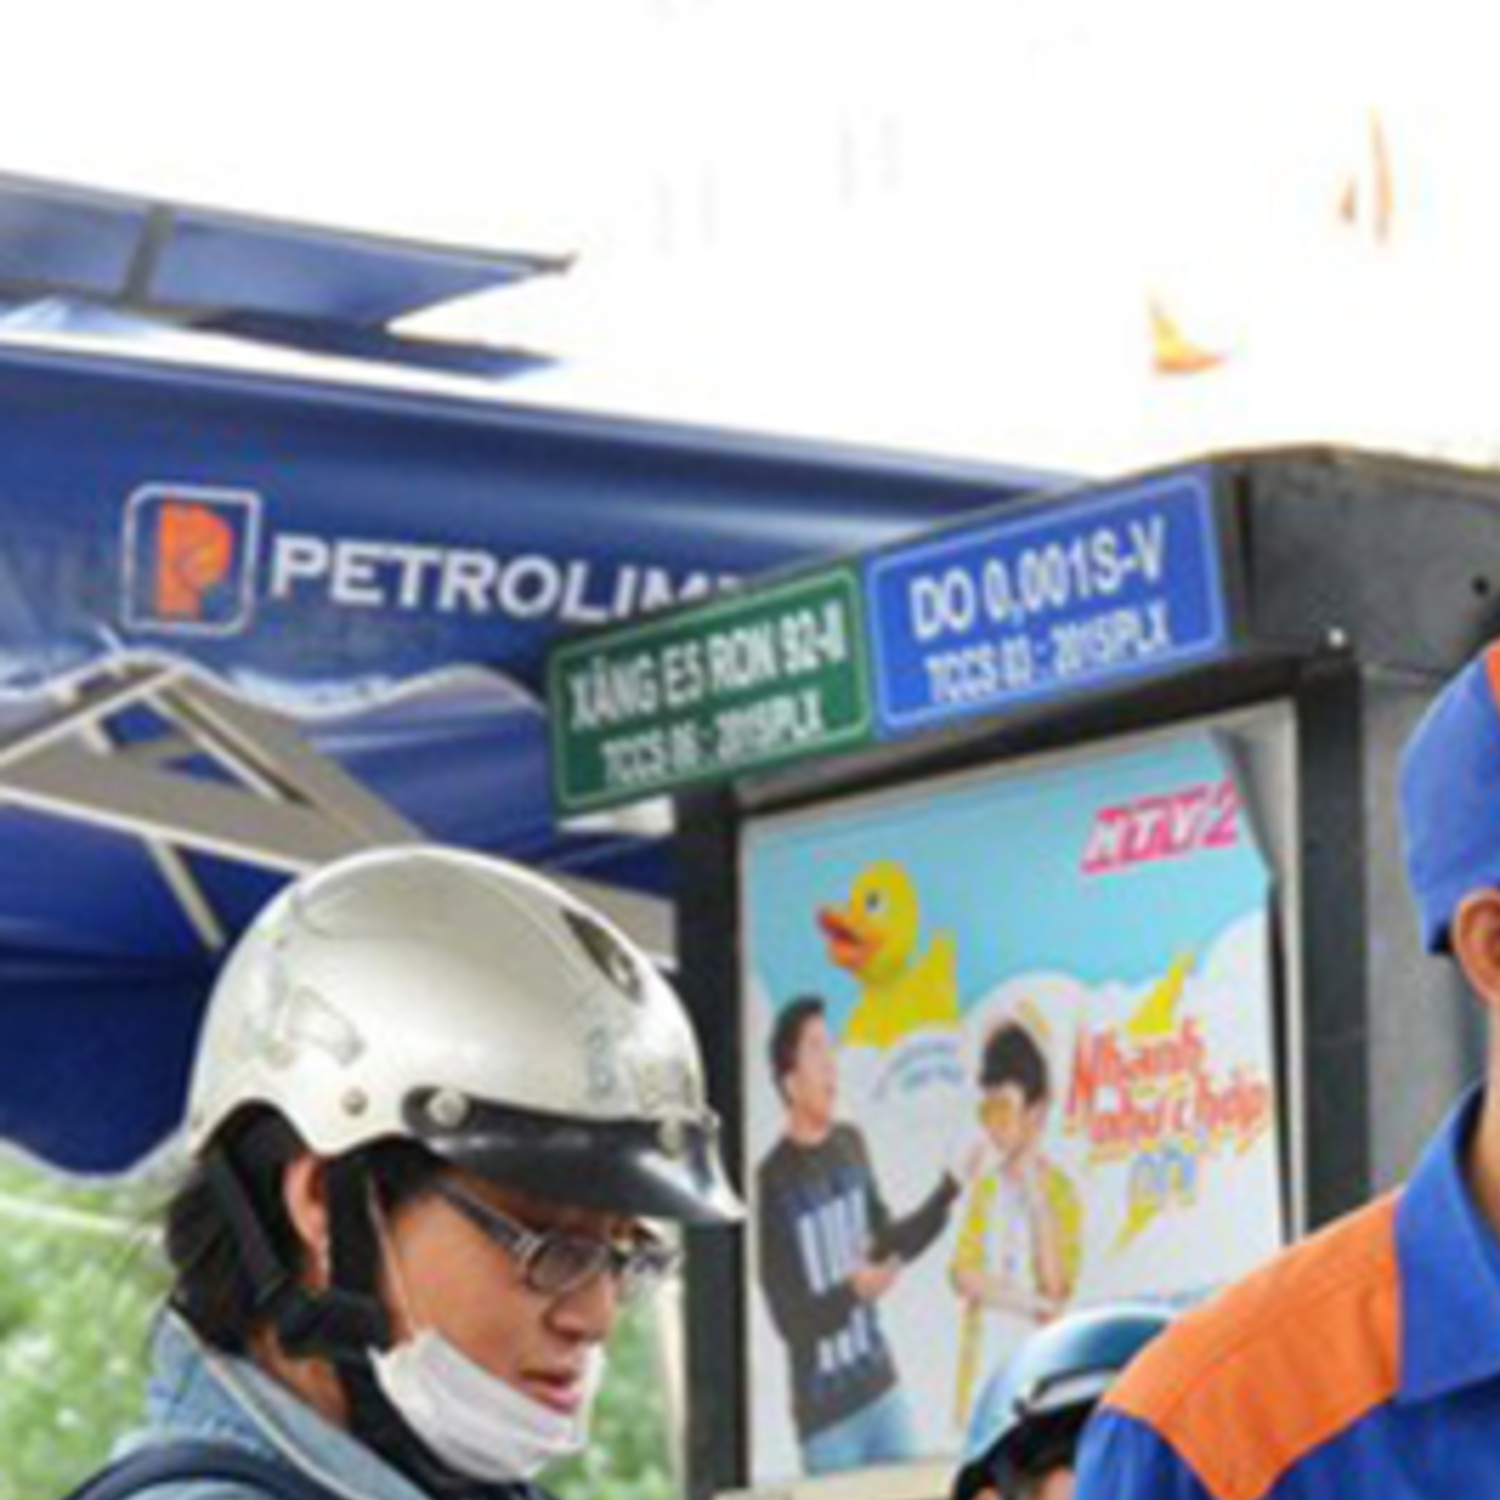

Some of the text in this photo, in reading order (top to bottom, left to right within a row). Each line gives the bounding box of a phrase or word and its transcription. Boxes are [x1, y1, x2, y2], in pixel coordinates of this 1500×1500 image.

[270, 534, 742, 623] PETROLIM
[909, 566, 976, 641] DO
[662, 640, 702, 708] E5
[707, 618, 778, 694] RON
[1080, 780, 1240, 874] HTV2
